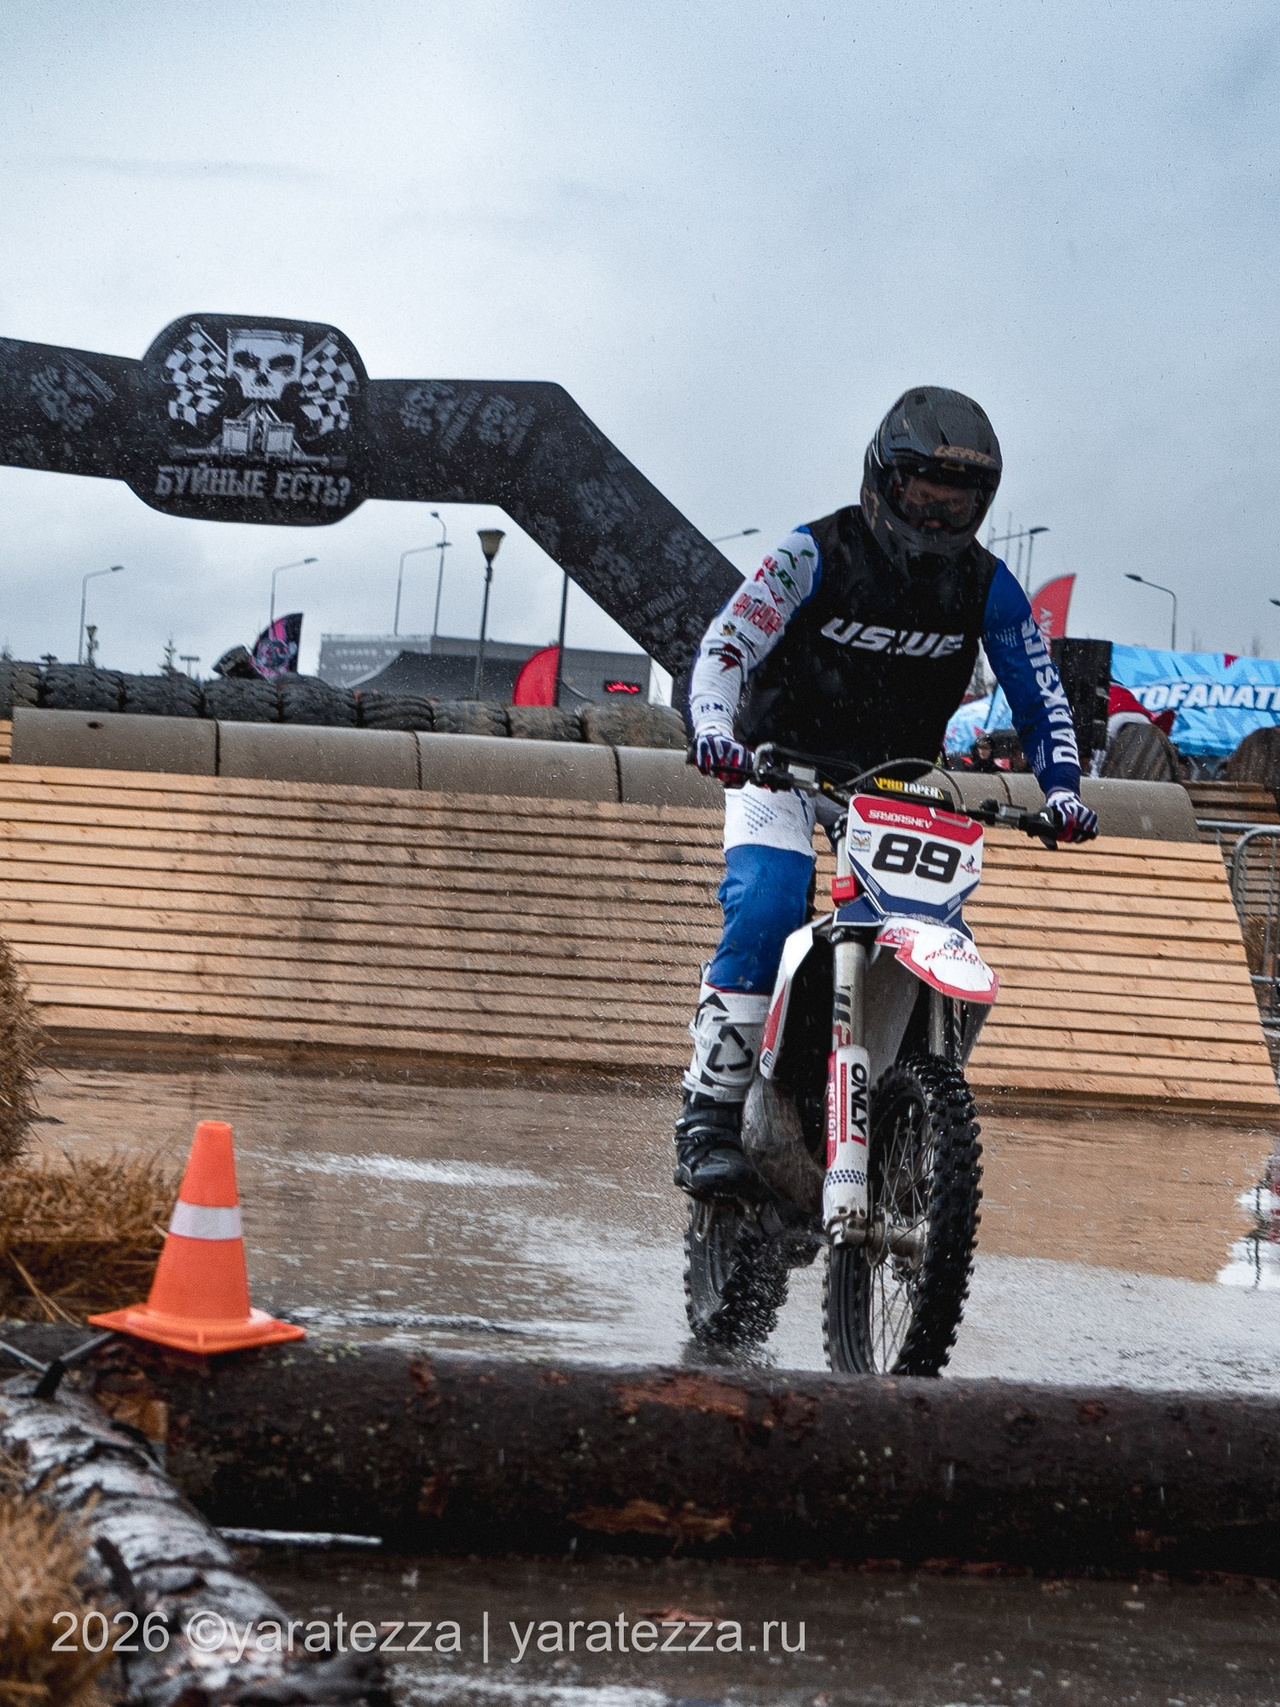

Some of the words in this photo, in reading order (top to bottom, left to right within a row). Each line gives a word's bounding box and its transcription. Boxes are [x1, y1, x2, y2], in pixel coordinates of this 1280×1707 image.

[154, 462, 267, 499] БУЙНЫЕ
[273, 470, 351, 507] ЕСТЬ?
[821, 617, 965, 659] USWE
[871, 832, 962, 884] 89
